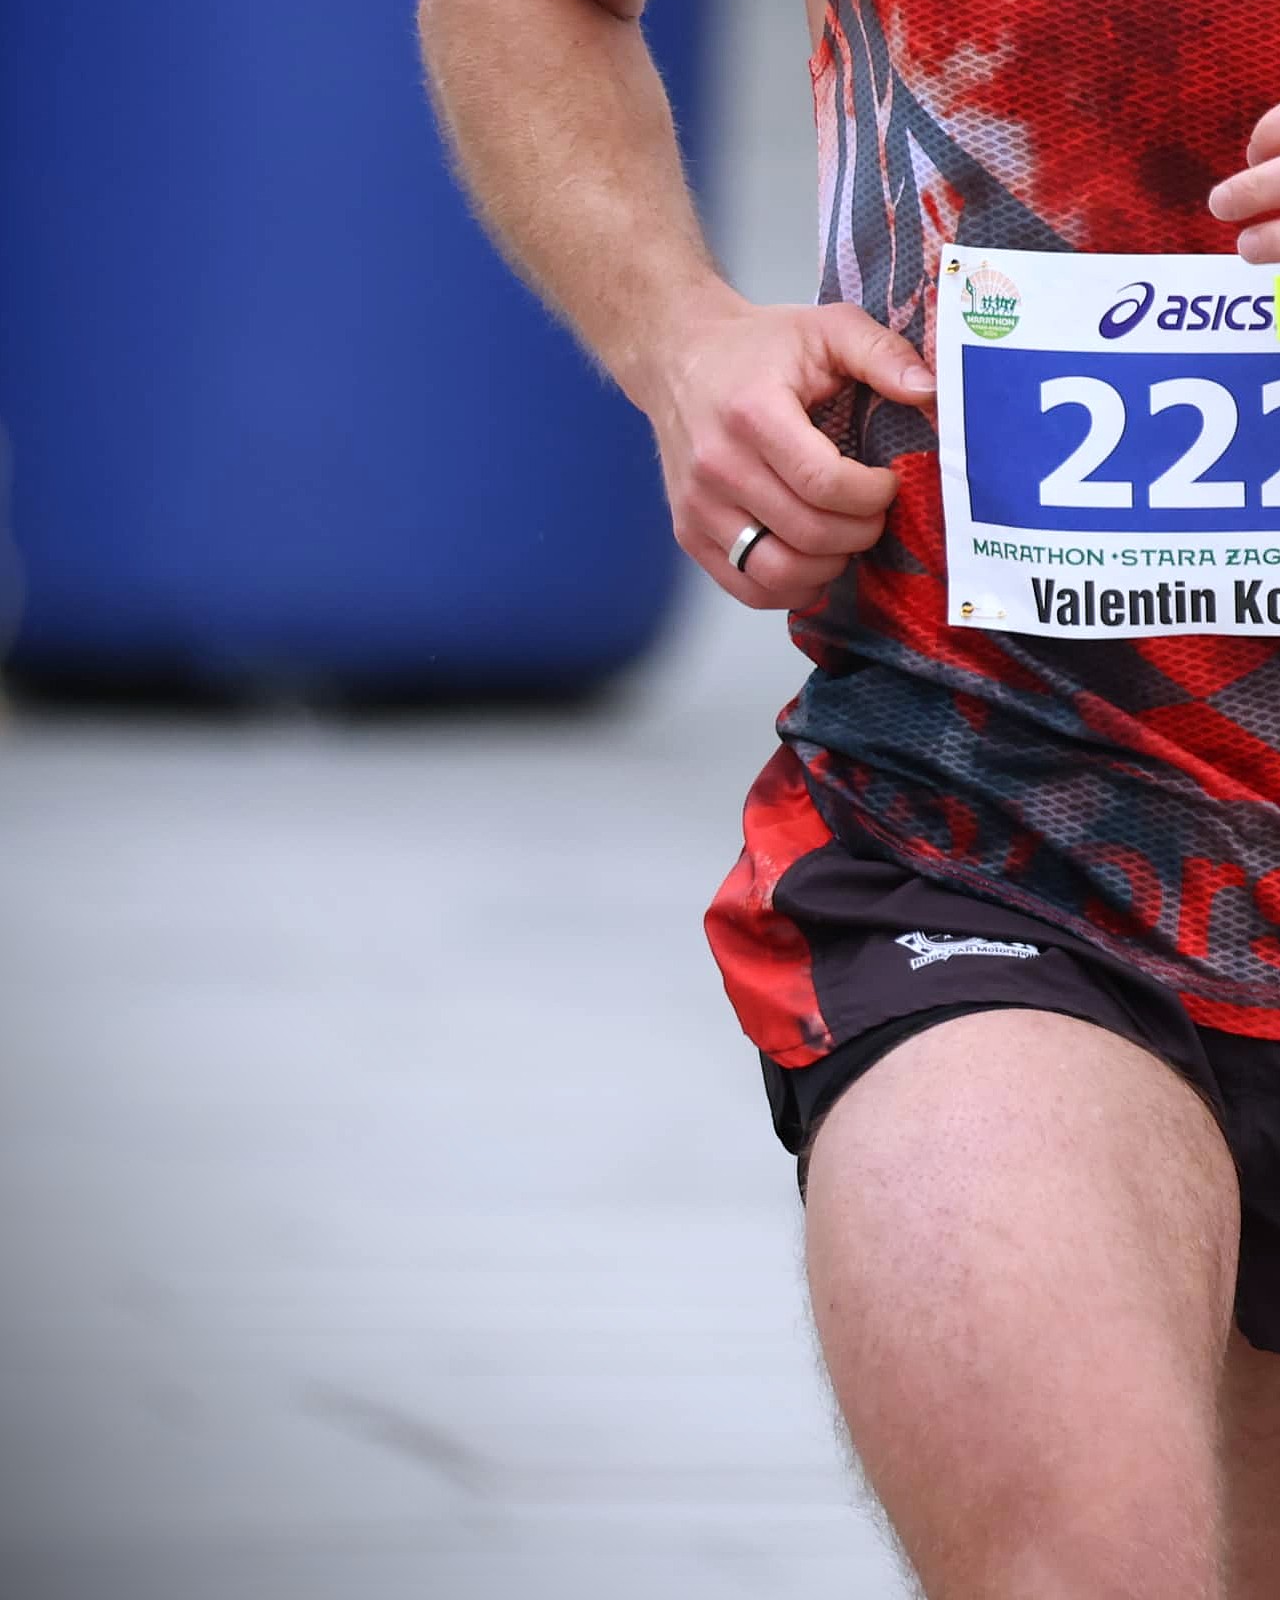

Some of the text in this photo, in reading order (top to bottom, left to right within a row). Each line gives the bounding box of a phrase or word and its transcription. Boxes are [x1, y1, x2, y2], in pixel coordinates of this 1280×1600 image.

[1157, 294, 1276, 331] asics
[972, 536, 1104, 567] MARATHON
[1031, 576, 1219, 628] Valentin
